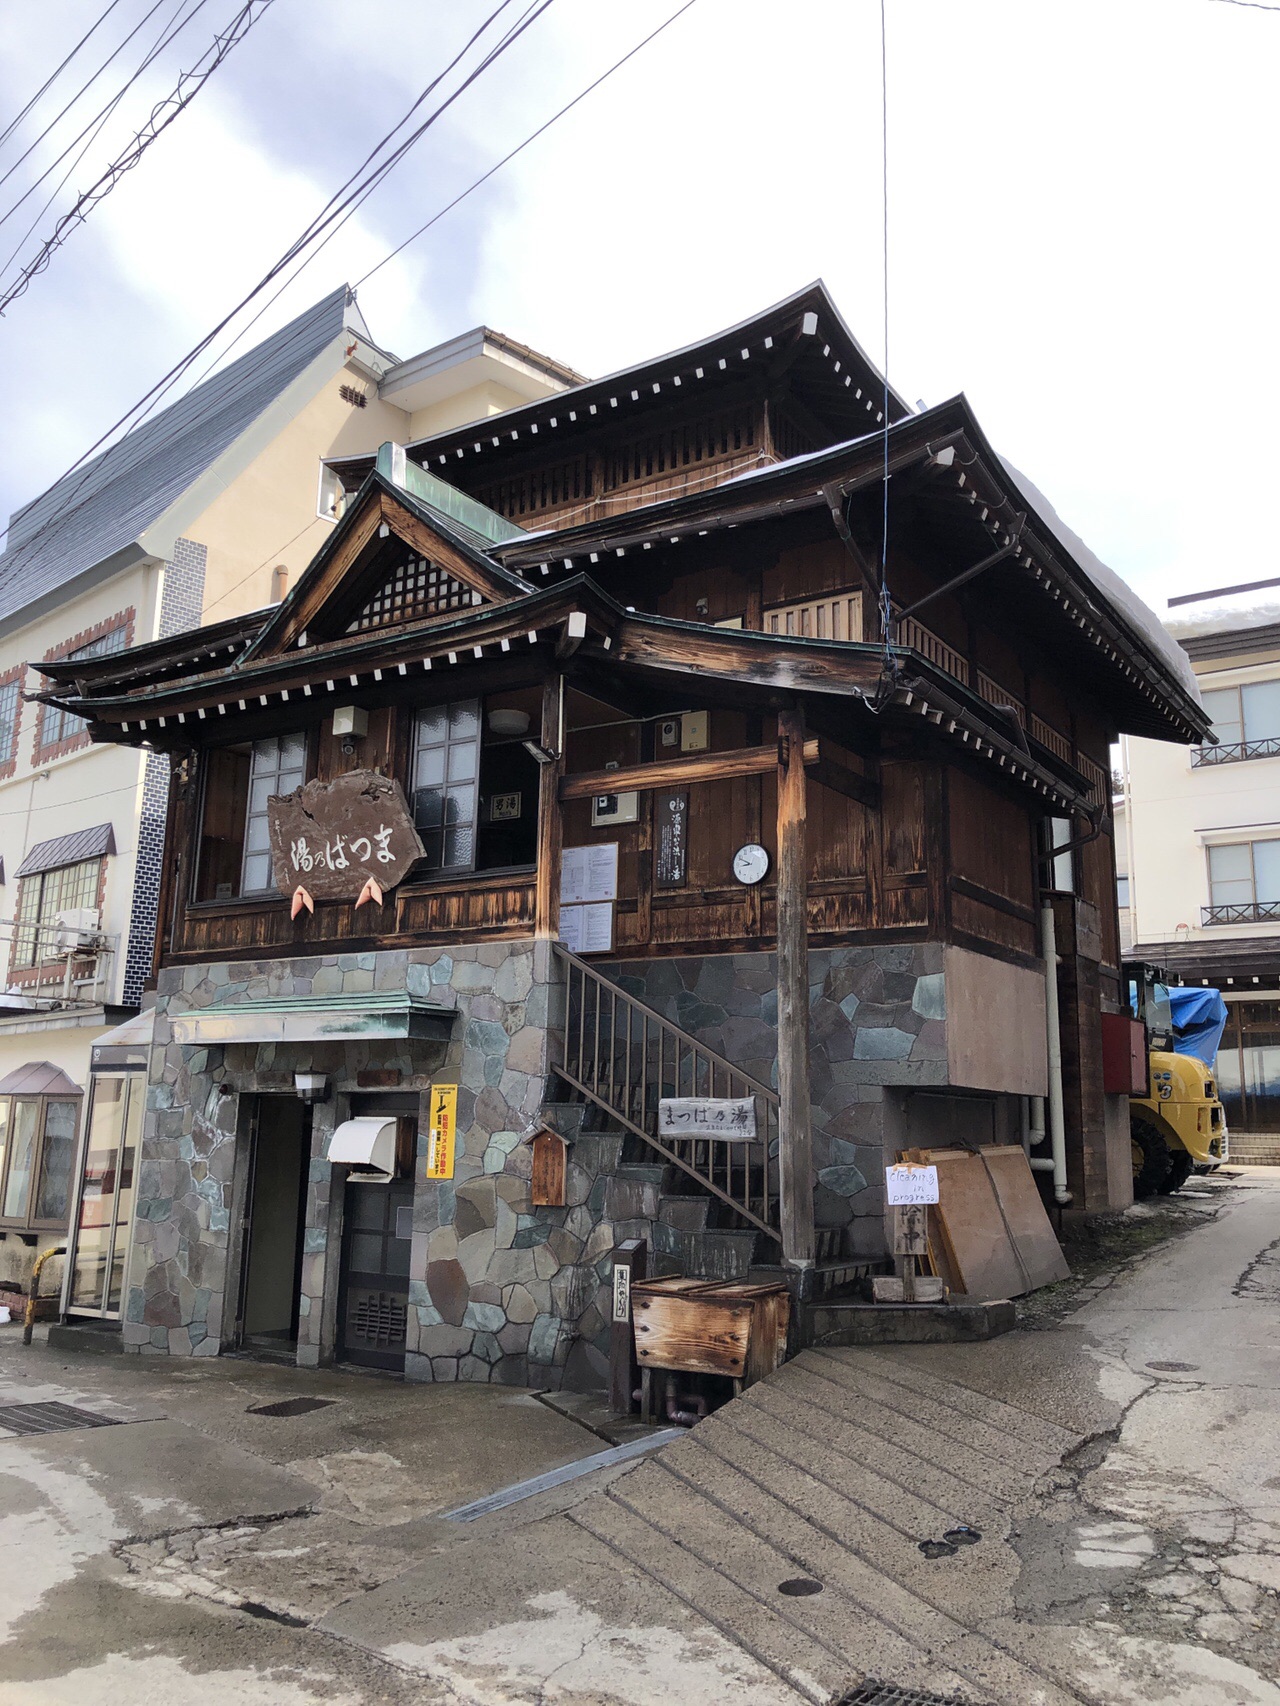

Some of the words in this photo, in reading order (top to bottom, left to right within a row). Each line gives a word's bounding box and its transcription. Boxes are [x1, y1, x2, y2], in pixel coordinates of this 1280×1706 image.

[665, 1104, 749, 1126] まつば乃湯
